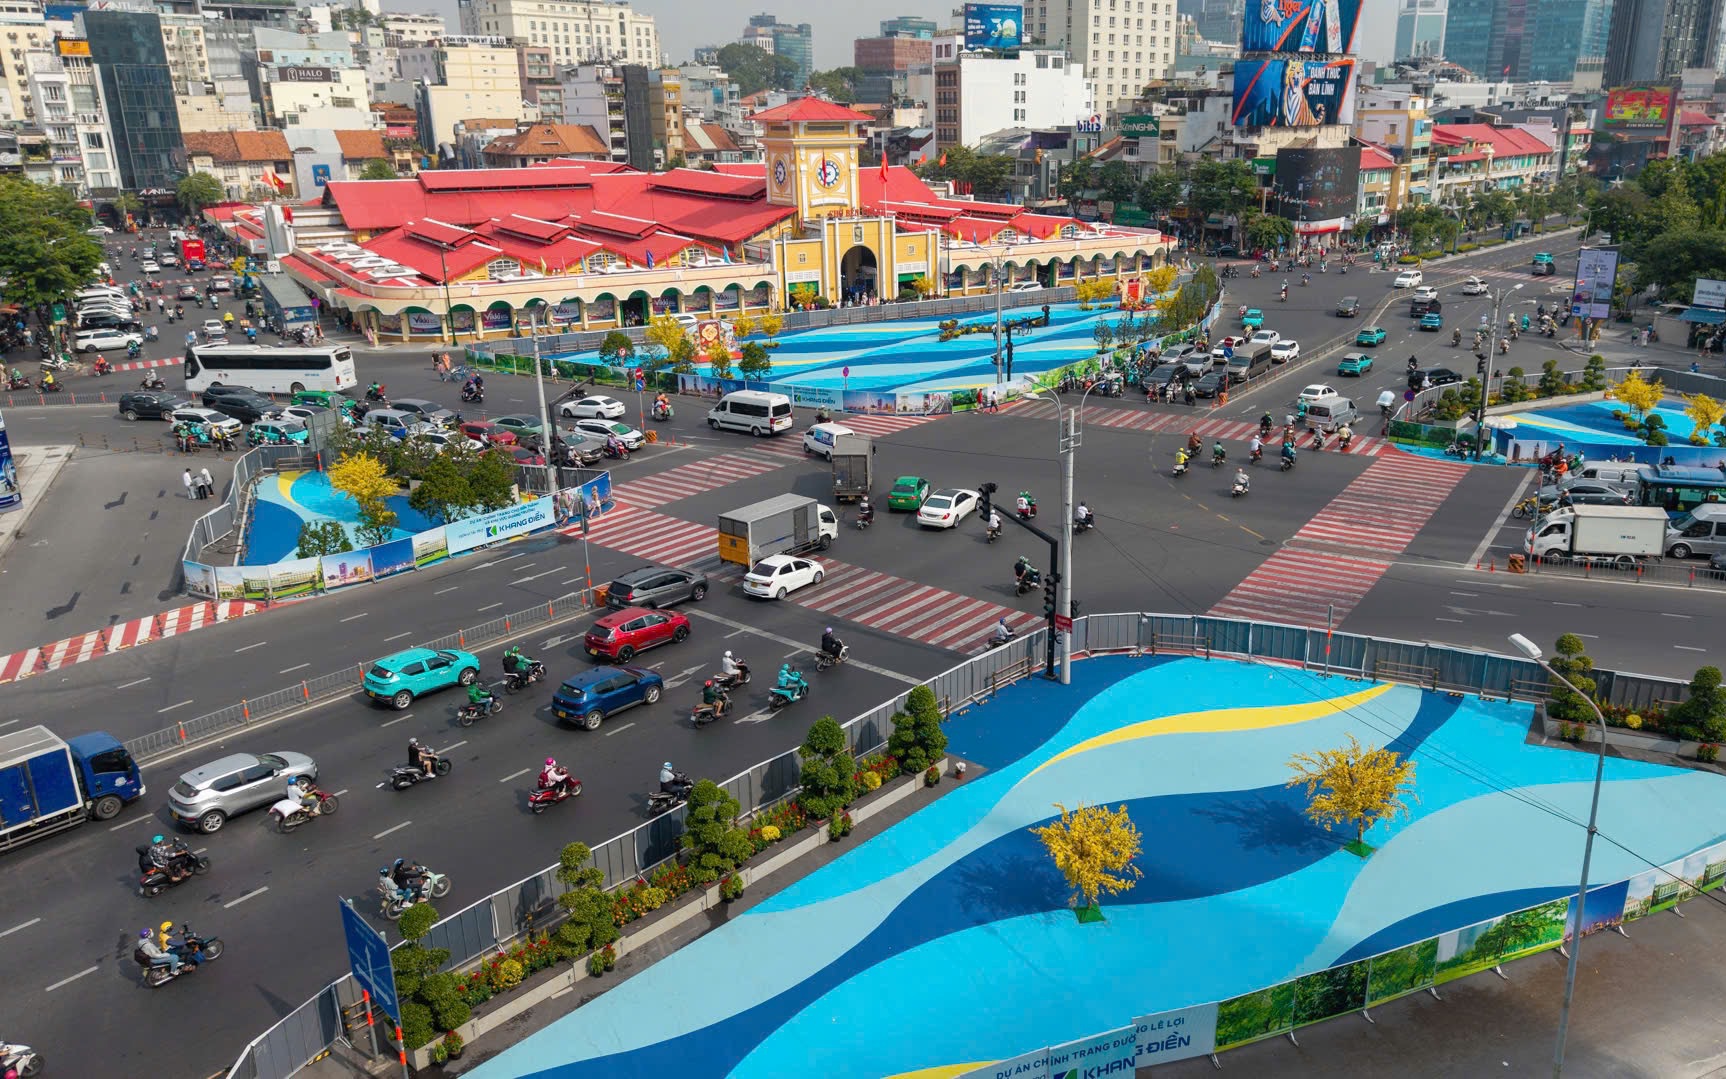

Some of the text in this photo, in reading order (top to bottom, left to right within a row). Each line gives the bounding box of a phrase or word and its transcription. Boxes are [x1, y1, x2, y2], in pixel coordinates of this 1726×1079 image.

[413, 314, 430, 323] Vikki
[484, 310, 501, 320] Vikki
[499, 517, 528, 533] KHANG
[1014, 1063, 1031, 1076] ÁN
[1033, 1054, 1069, 1068] CHỈNH
[1072, 1042, 1111, 1060] TRANG
[1150, 1019, 1165, 1031] LÊ
[1166, 1016, 1185, 1029] LỢI
[1145, 1031, 1191, 1054] ĐIỀN
